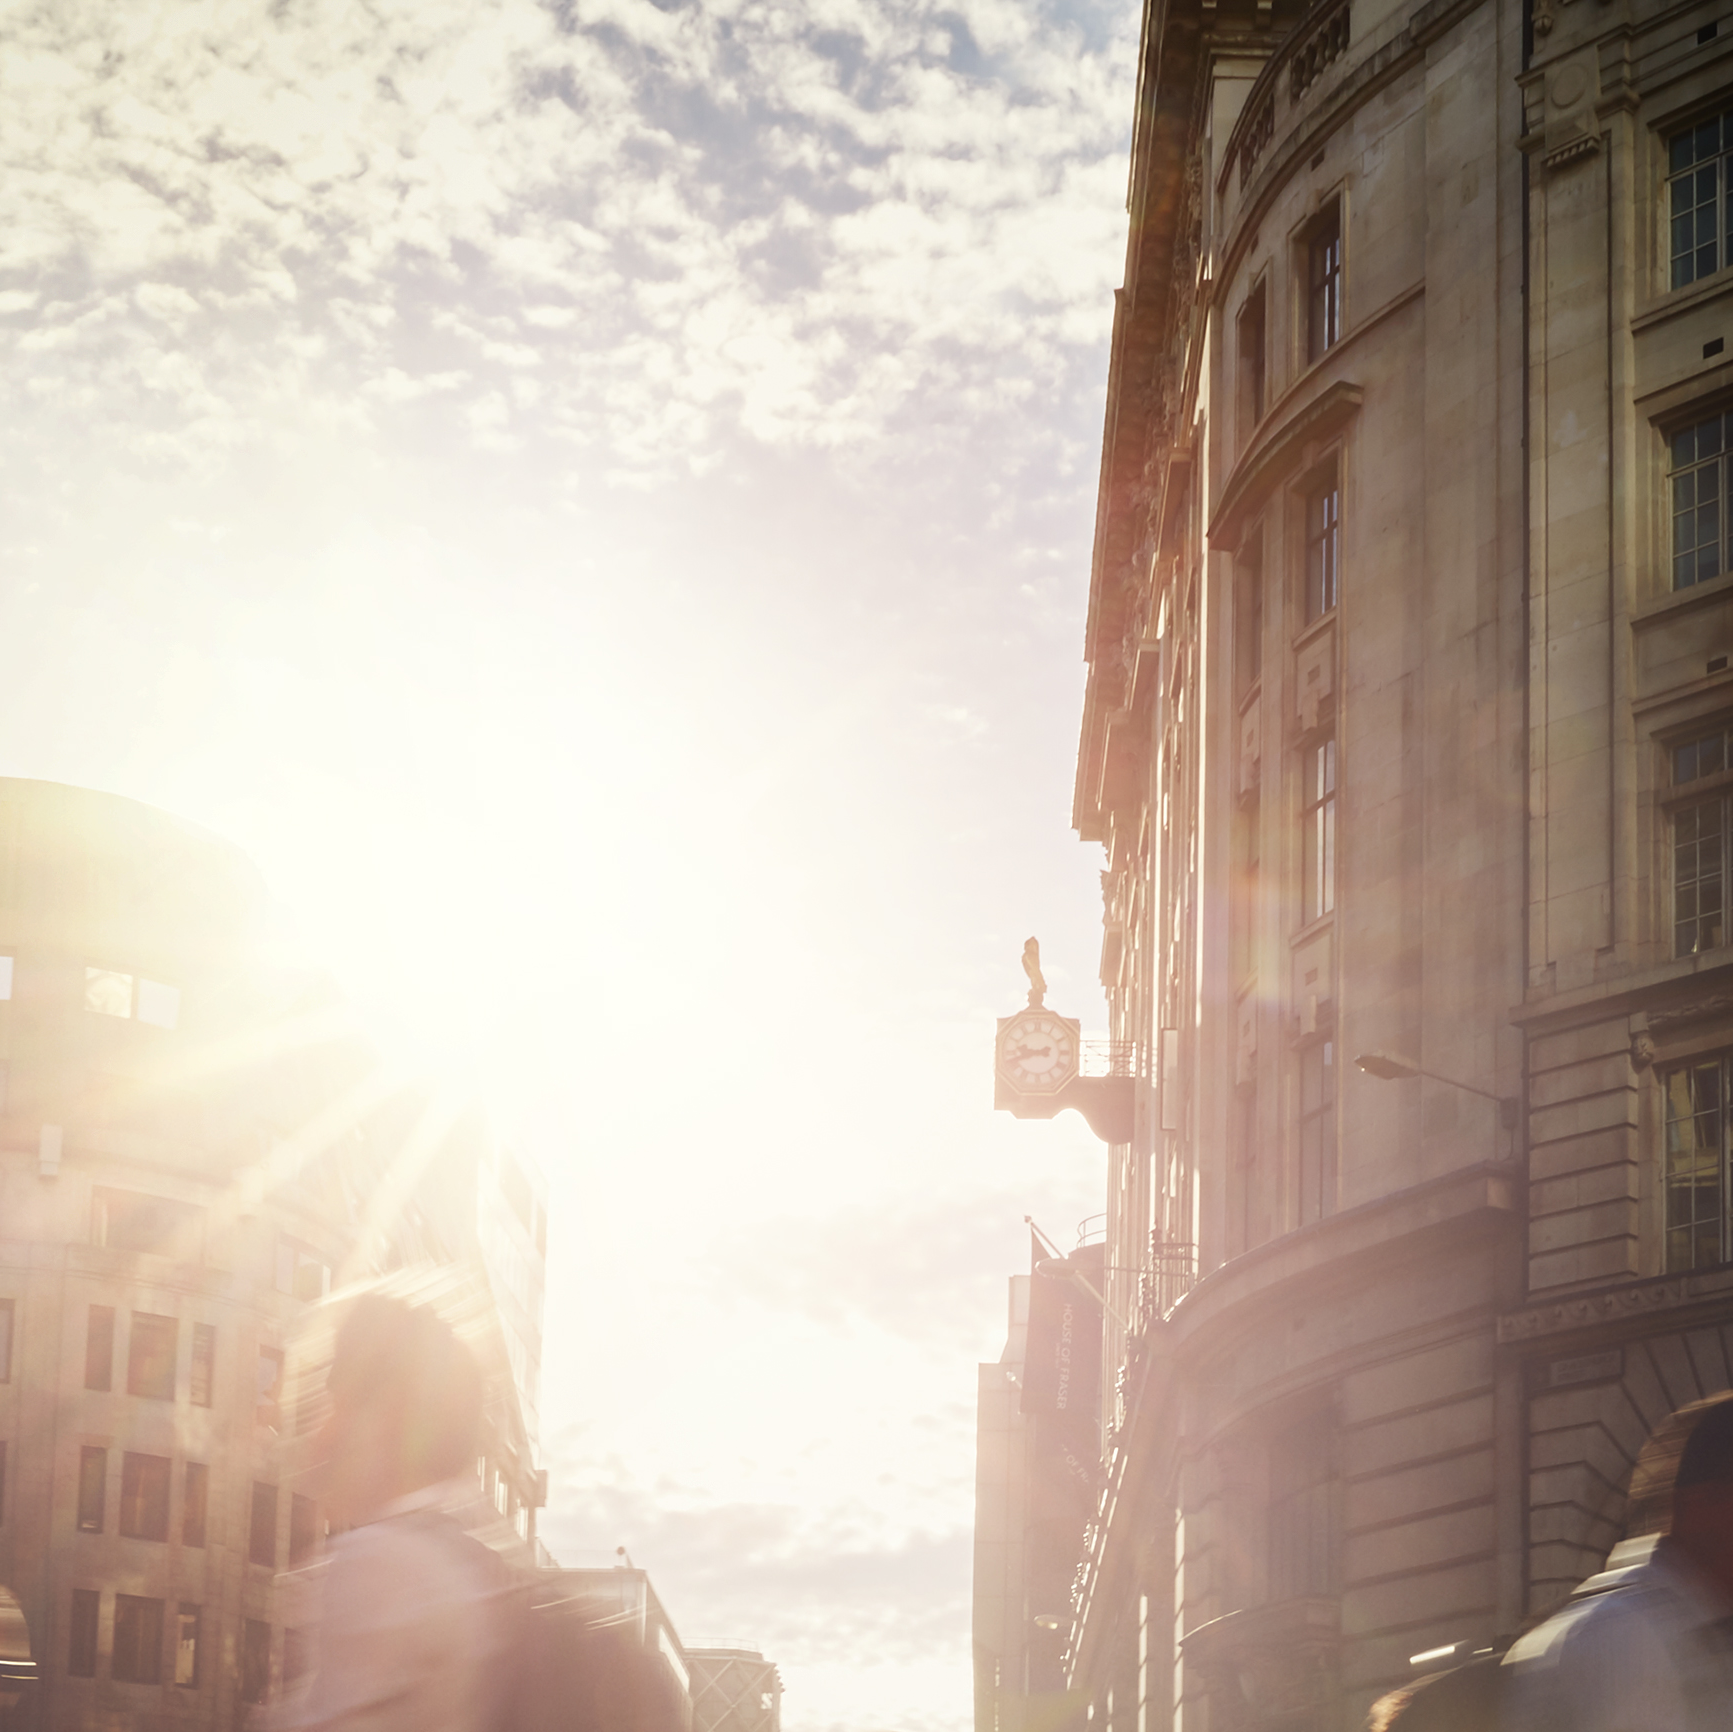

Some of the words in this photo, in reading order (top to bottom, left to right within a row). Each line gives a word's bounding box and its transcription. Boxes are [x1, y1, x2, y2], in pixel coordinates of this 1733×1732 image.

[1061, 1303, 1074, 1344] HOUSE
[1060, 1347, 1071, 1365] OF
[1056, 1367, 1070, 1410] FRASER
